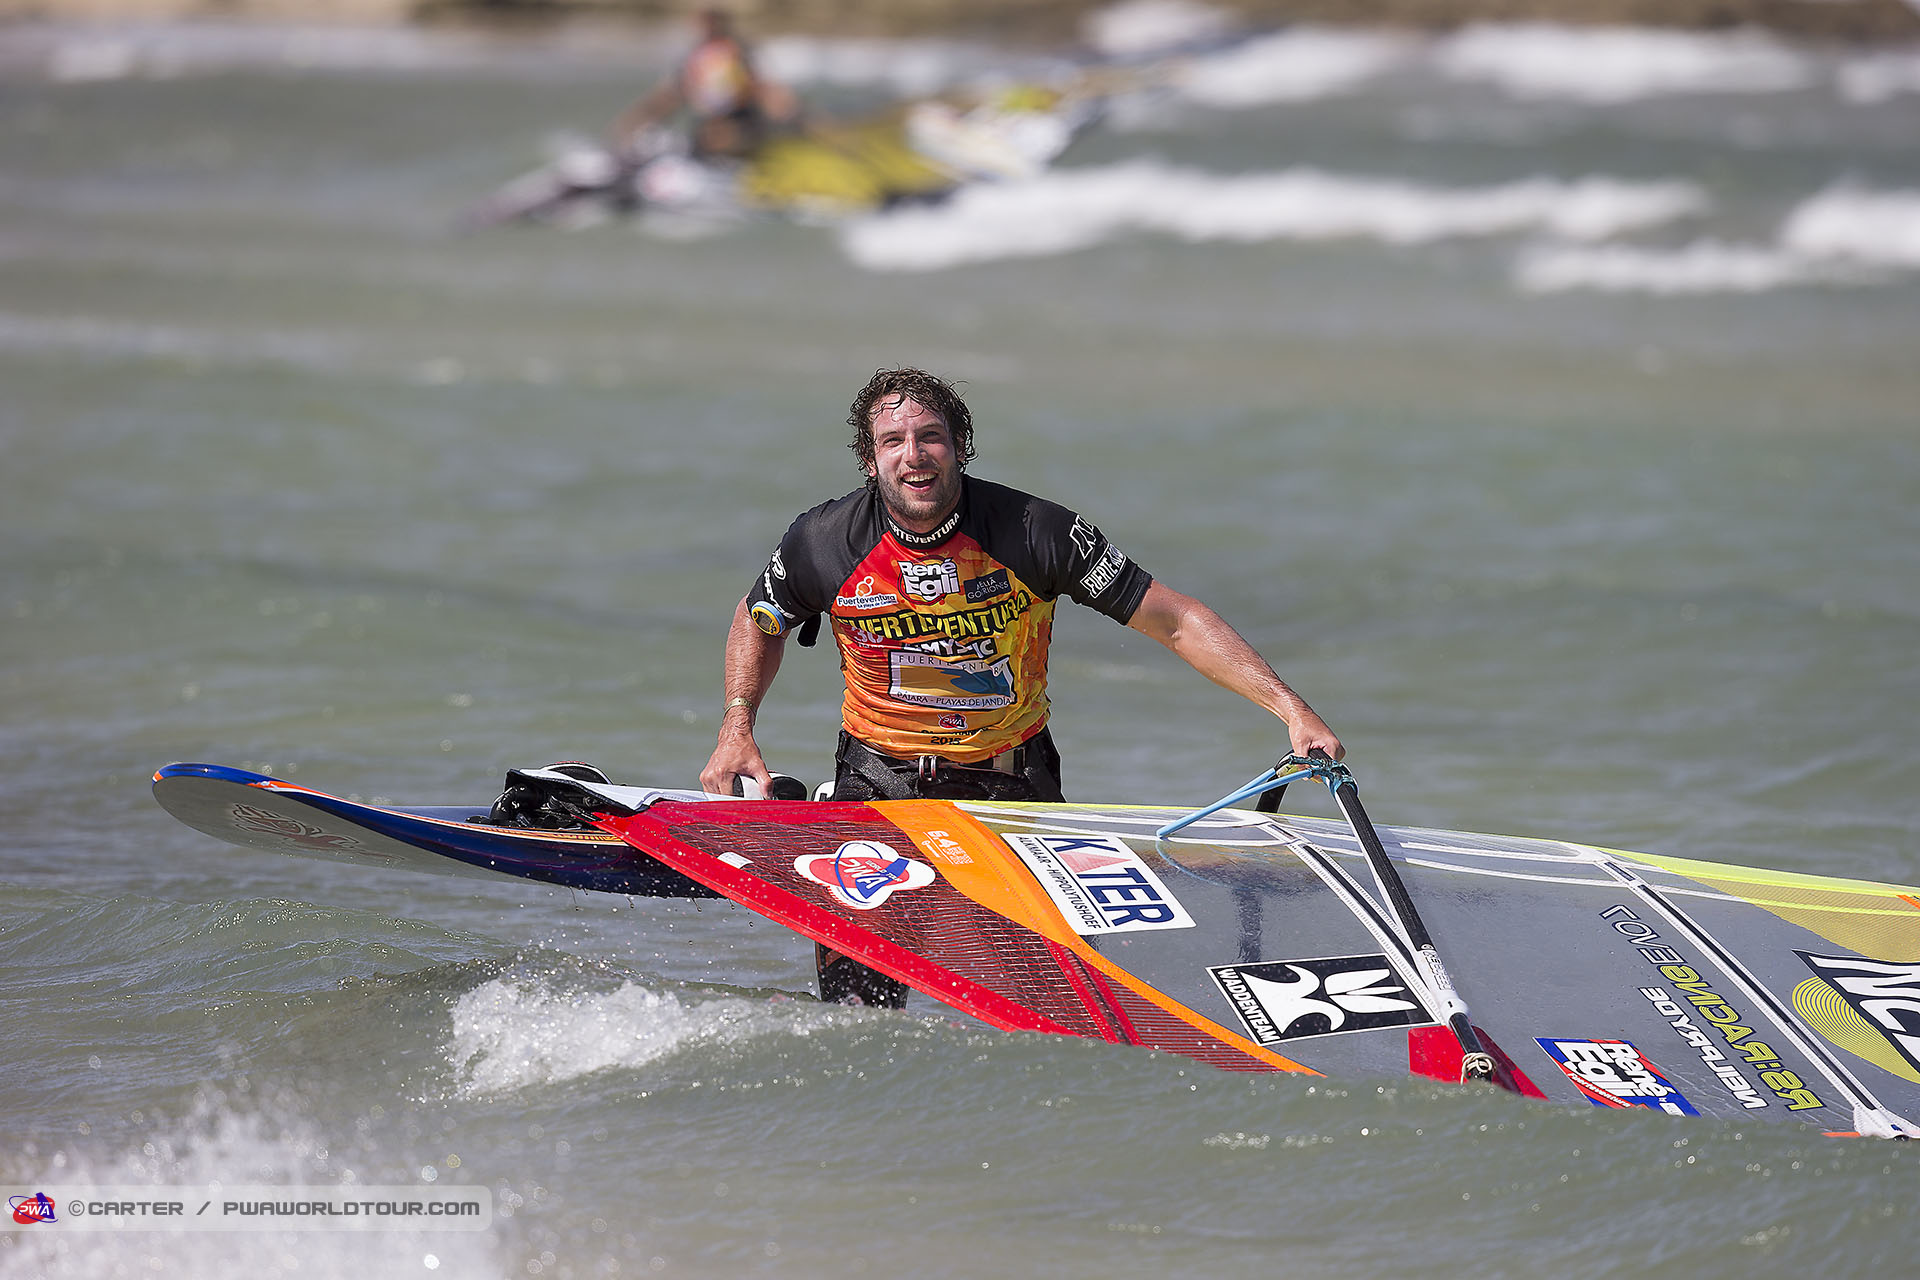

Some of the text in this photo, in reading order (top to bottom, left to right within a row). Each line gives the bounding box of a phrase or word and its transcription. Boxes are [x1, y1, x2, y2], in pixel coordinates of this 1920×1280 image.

[888, 512, 960, 543] ERTEVENTURA
[898, 558, 957, 577] René
[1083, 557, 1118, 595] FUERTE
[837, 594, 896, 606] Fuerteventura
[903, 574, 960, 602] Egli
[936, 697, 967, 707] PLAYAS
[968, 697, 980, 706] DE
[930, 736, 962, 745] 2015
[1016, 835, 1051, 865] ALKMAAR
[1217, 967, 1281, 1043] WADDENTEAM
[1552, 1041, 1642, 1097] Egli
[1598, 1042, 1677, 1098] René
